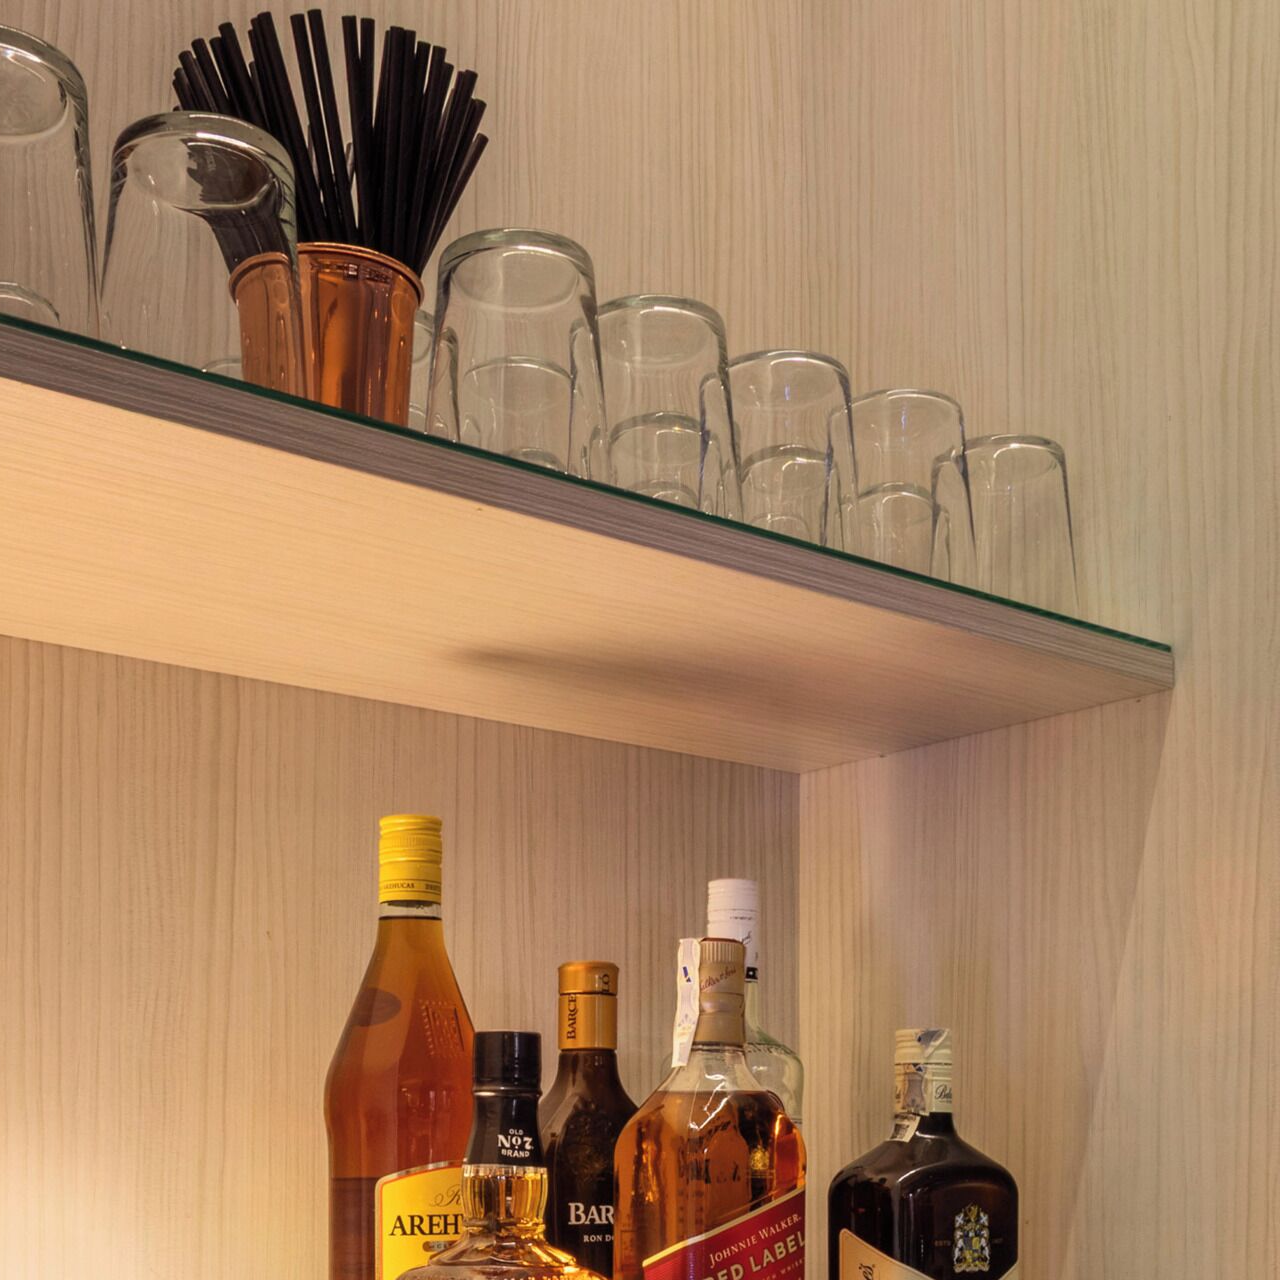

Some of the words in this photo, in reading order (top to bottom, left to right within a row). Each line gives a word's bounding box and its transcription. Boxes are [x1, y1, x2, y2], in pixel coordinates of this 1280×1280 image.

[501, 1149, 530, 1158] BRAND
[389, 1213, 463, 1236] AREH
[583, 1234, 603, 1243] RON
[709, 1234, 758, 1269] JOHNNIE
[758, 1213, 801, 1241] WALKER
[750, 1230, 805, 1272] LABEL
